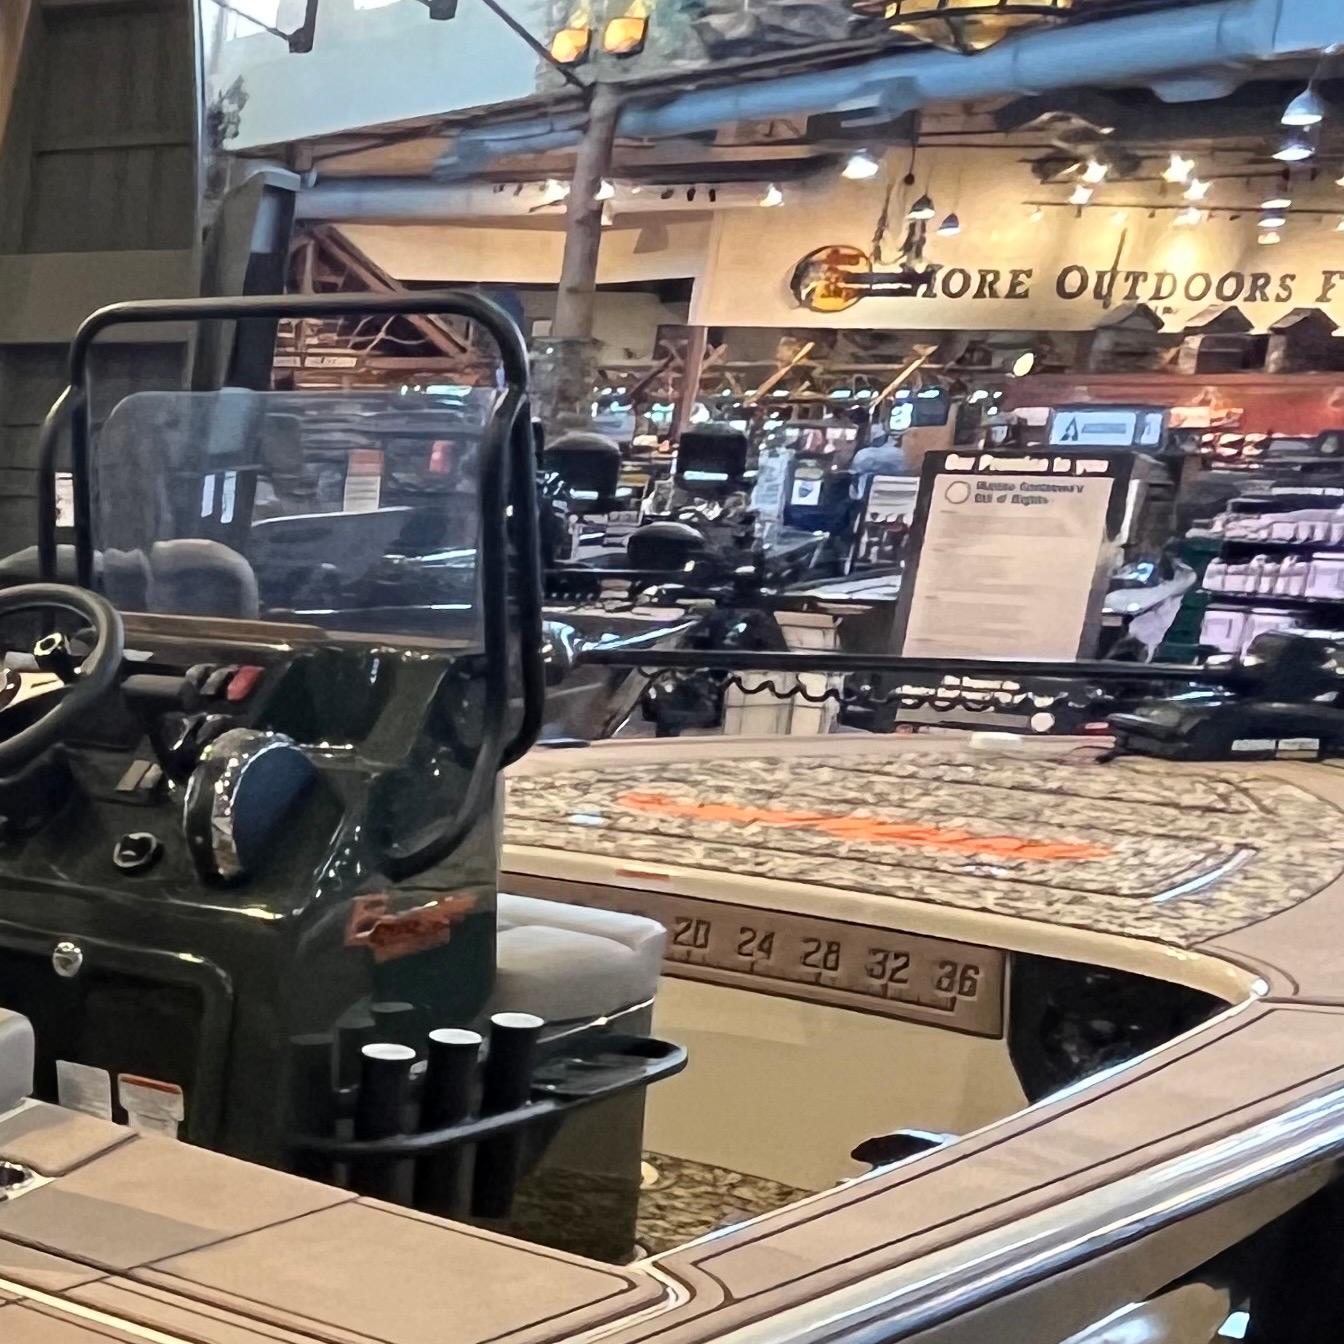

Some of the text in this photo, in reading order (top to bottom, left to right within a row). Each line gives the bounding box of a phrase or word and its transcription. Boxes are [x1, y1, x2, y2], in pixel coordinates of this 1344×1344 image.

[1056, 264, 1297, 308] OUTDOORS
[674, 916, 980, 997] 20 24 28 32 36
